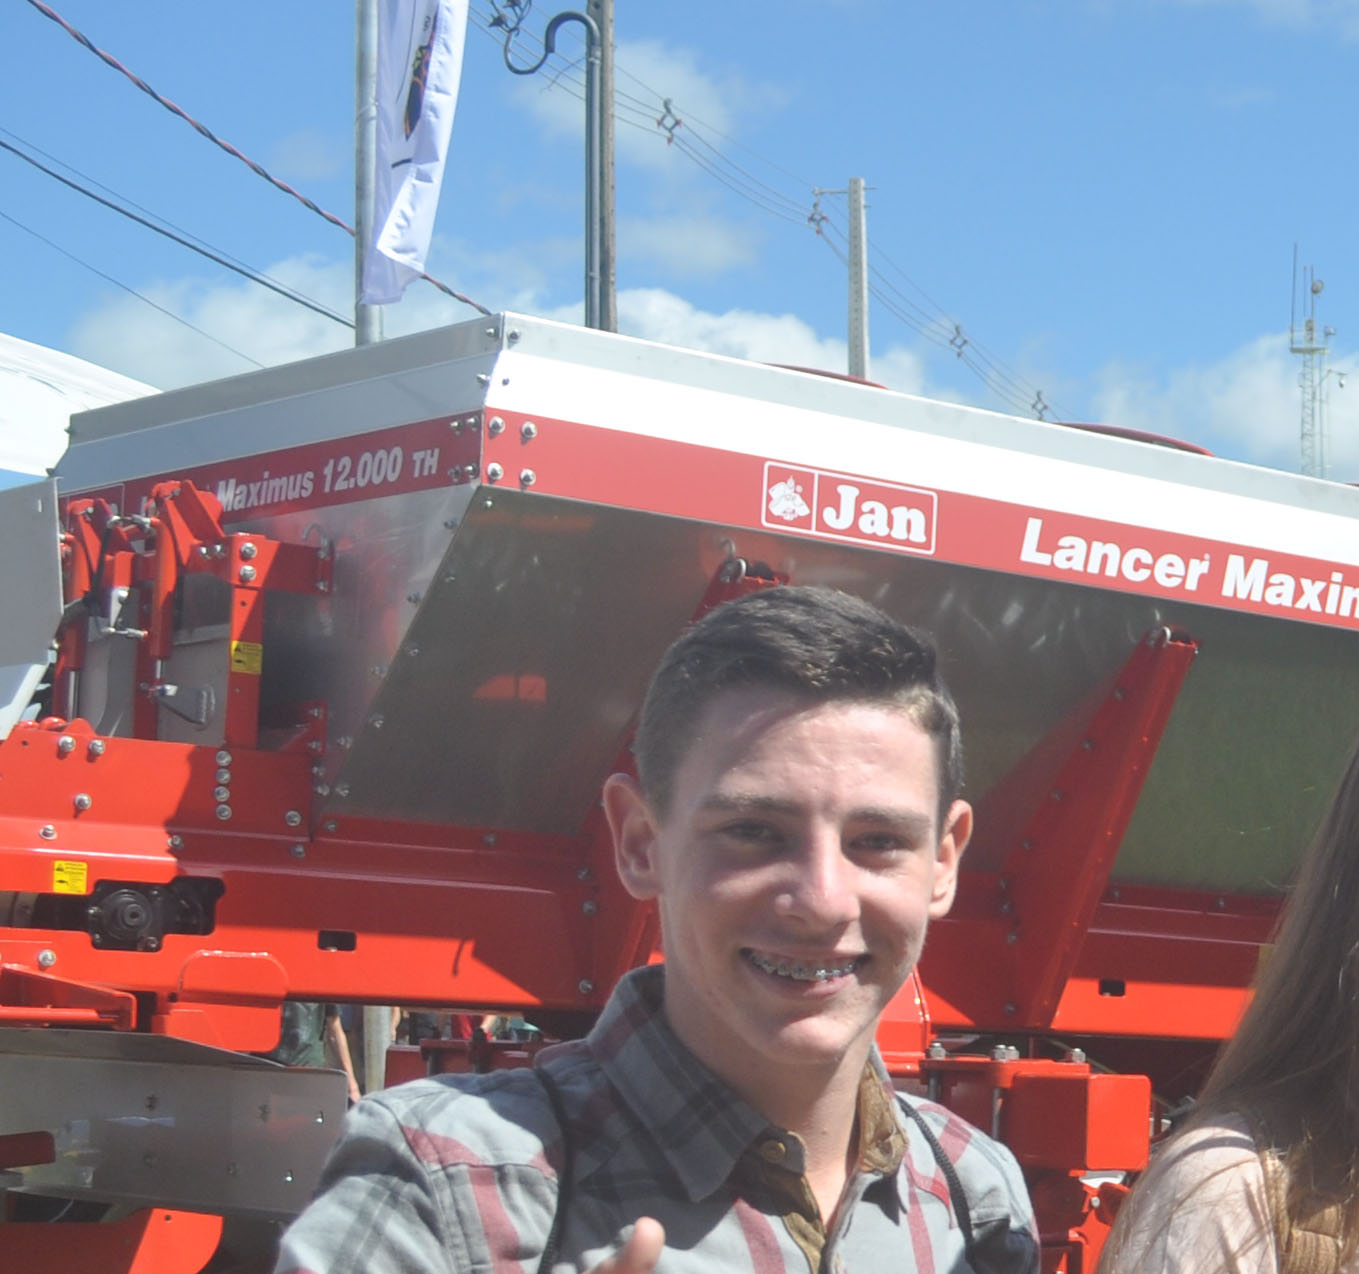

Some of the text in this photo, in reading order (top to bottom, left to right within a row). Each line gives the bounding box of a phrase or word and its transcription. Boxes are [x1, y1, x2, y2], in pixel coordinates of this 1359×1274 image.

[217, 446, 440, 513] Maximus 12.000 TH
[823, 485, 928, 544] Jan
[1020, 517, 1208, 591] Lancer
